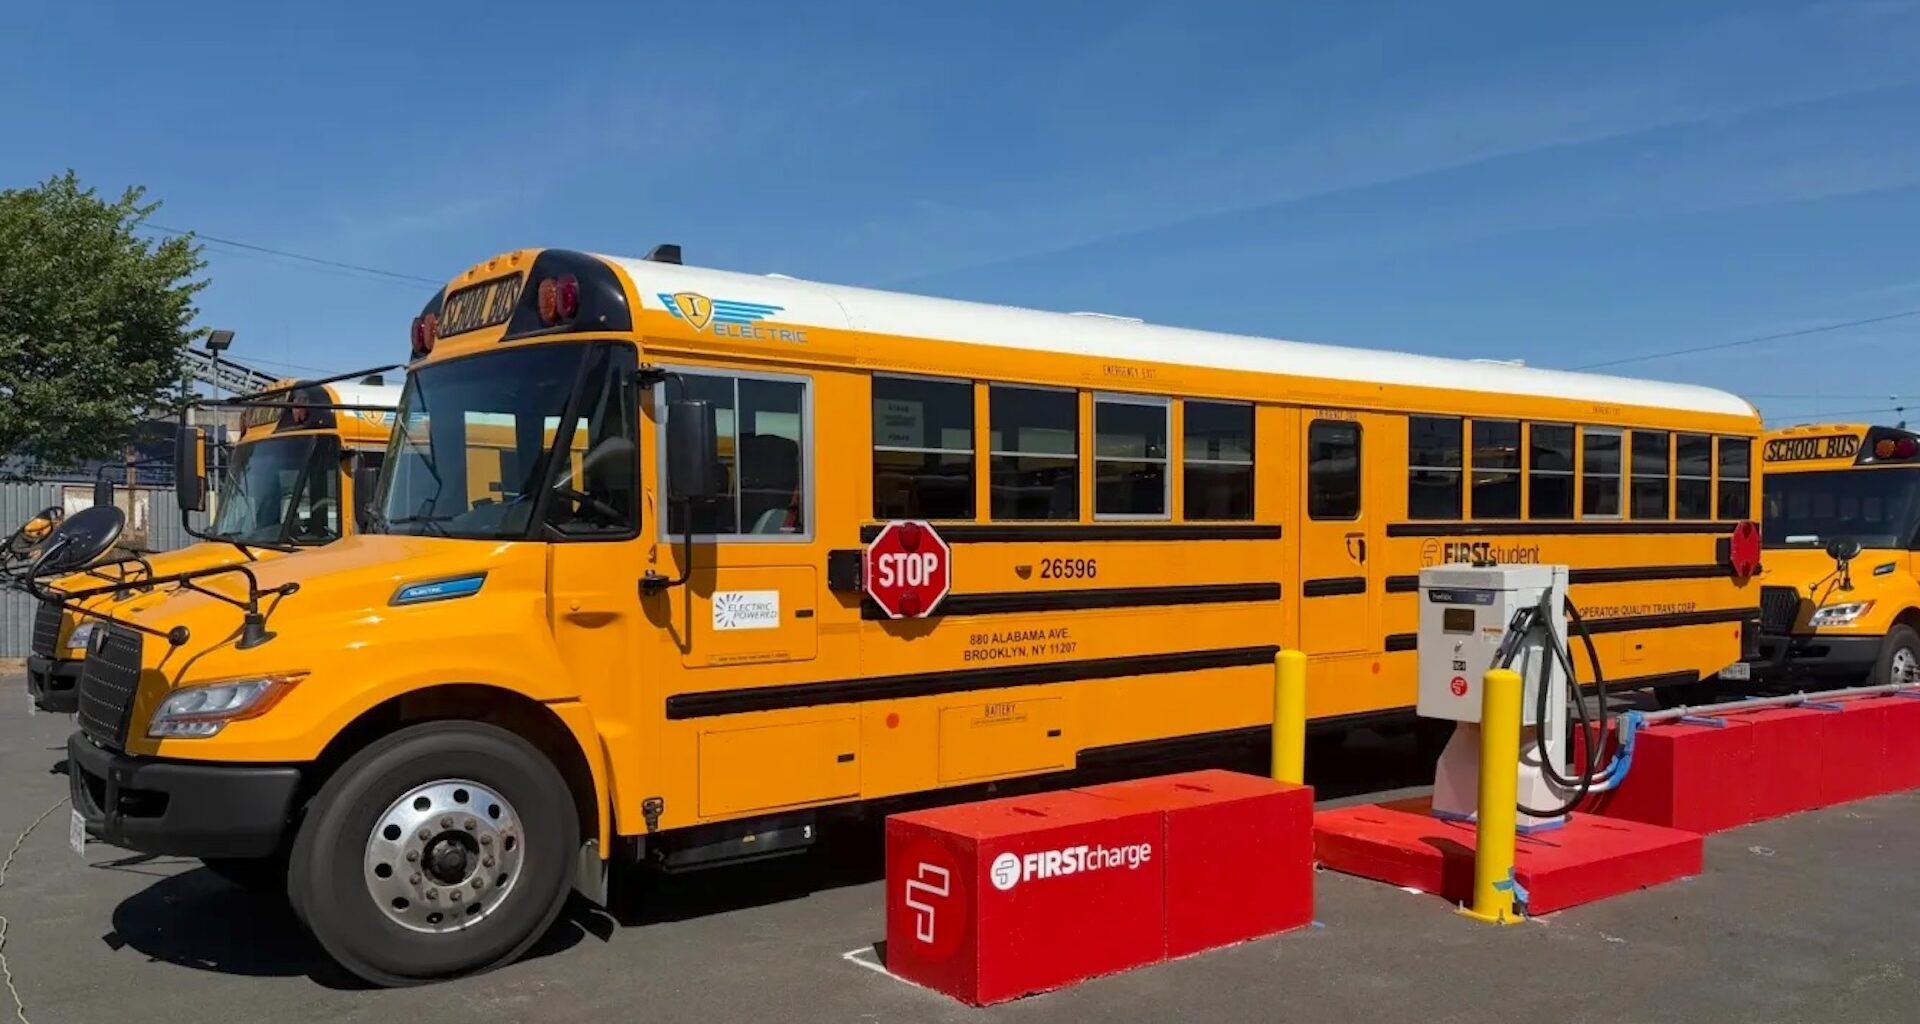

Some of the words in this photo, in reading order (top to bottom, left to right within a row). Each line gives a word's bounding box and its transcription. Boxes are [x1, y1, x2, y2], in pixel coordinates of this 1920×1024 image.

[441, 285, 490, 335] SCHOOL
[487, 277, 521, 323] BUS
[713, 324, 809, 343] ELECTRIC
[1767, 438, 1822, 460] SCHOOL
[1826, 436, 1857, 457] BUS
[879, 552, 939, 588] STOP
[1040, 558, 1097, 579] 26596
[728, 602, 772, 611] ELECTRIC
[732, 611, 777, 620] POWERED
[1621, 604, 1651, 615] QUALITY
[969, 634, 989, 646] 880
[991, 630, 1046, 645] ALABAMA
[964, 647, 1029, 662] BROOKLYN,
[1031, 644, 1047, 656] NY
[1049, 642, 1077, 654] 11207
[984, 703, 1017, 718] BATTERY
[1022, 843, 1152, 882] FIRSTcharge
